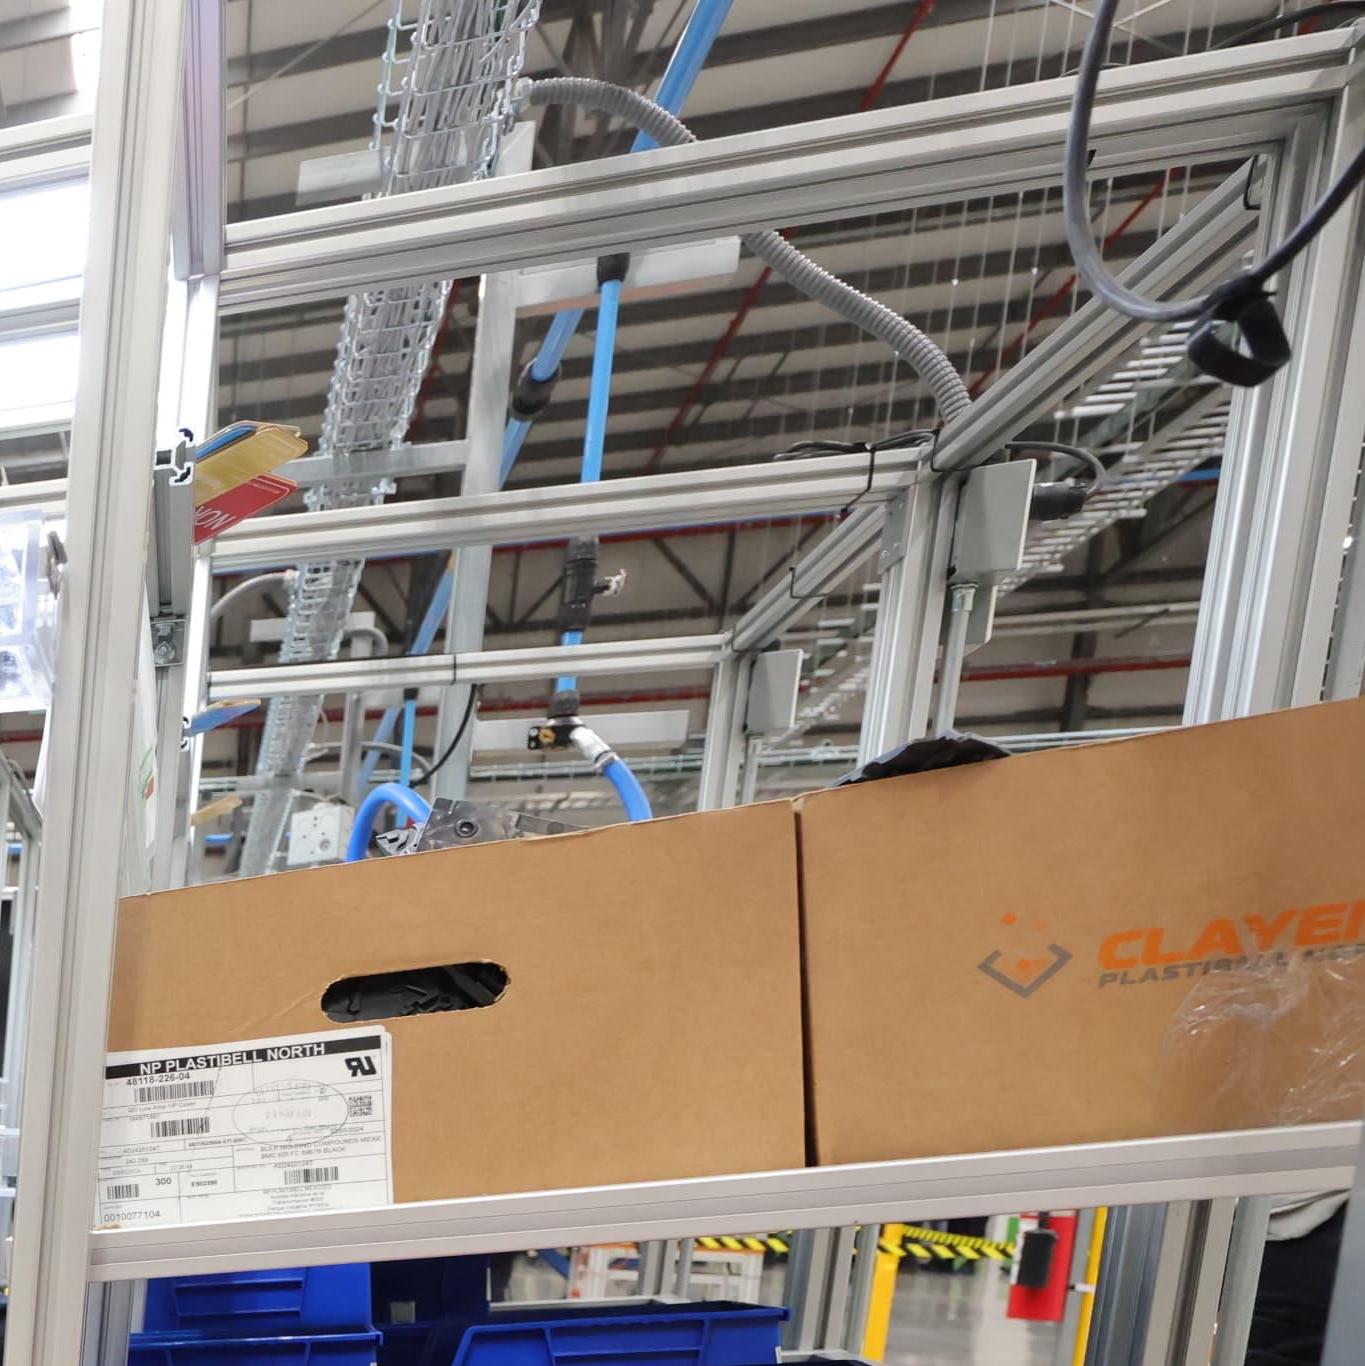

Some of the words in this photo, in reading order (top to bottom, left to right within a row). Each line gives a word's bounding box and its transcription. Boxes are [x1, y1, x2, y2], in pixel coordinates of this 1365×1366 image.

[140, 1062, 162, 1076] NP
[166, 1050, 263, 1072] PLASTIBELL
[267, 1043, 325, 1060] NORTH
[126, 1072, 190, 1086] 48118-226-04
[155, 1177, 172, 1186] 300
[103, 1210, 161, 1222] 0010077104
